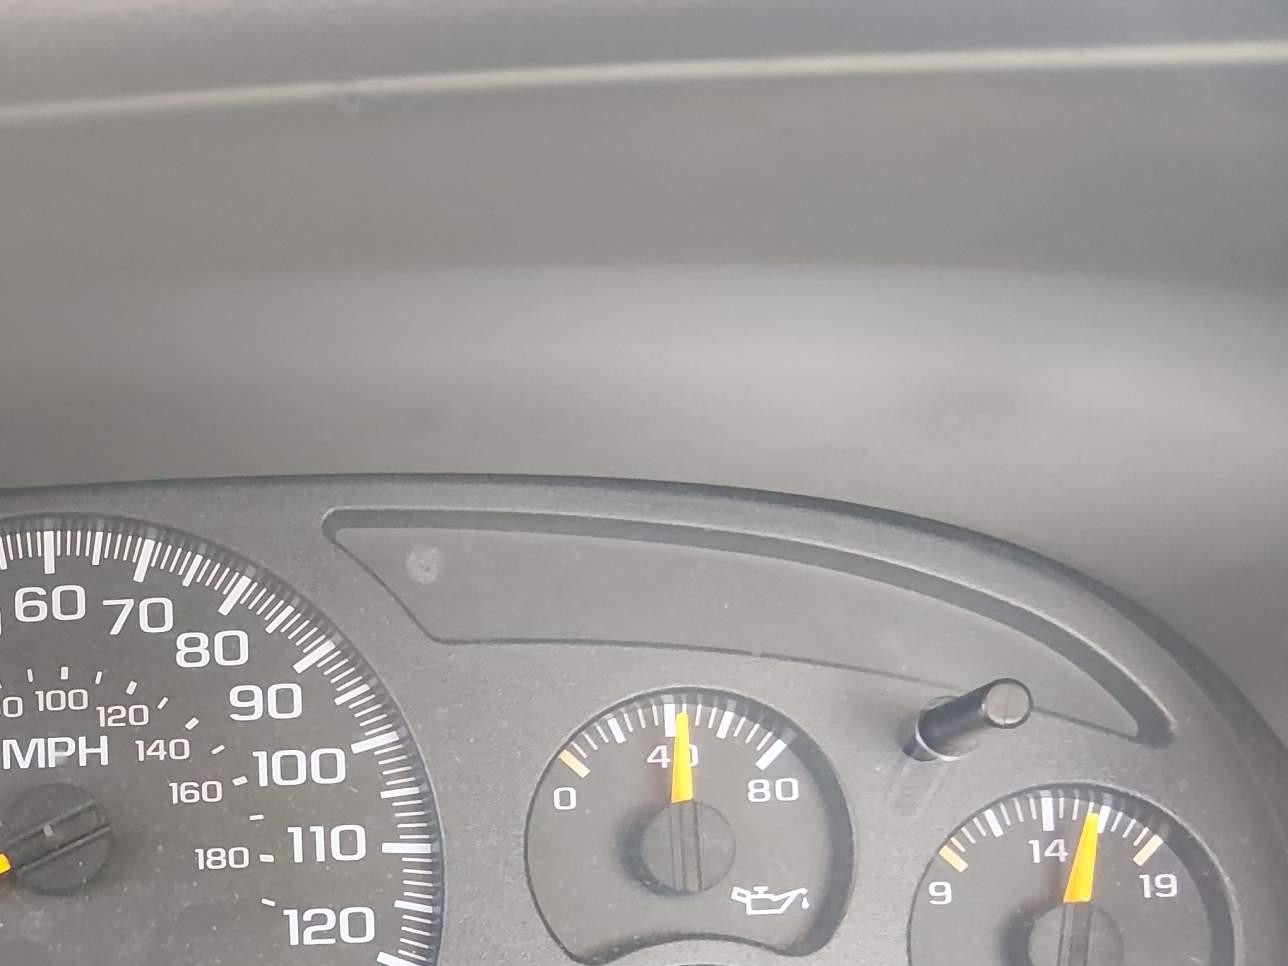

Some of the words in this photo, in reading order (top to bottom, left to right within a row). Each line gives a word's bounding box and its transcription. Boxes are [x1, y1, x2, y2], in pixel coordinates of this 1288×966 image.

[14, 584, 86, 623] 60
[102, 597, 174, 635] 70
[175, 630, 249, 668] 80
[35, 688, 89, 712] 100
[229, 683, 303, 721] 90
[95, 704, 149, 728] 120
[2, 735, 109, 770] MPH
[134, 738, 190, 762] 140
[252, 747, 346, 787] 100
[168, 780, 223, 804] 160
[553, 786, 577, 810] 0
[747, 777, 799, 803] 80
[287, 824, 367, 863] 110
[1028, 838, 1069, 864] 14
[194, 846, 250, 870] 180
[928, 881, 953, 905] 9
[1139, 873, 1178, 899] 19
[283, 906, 375, 946] 120
